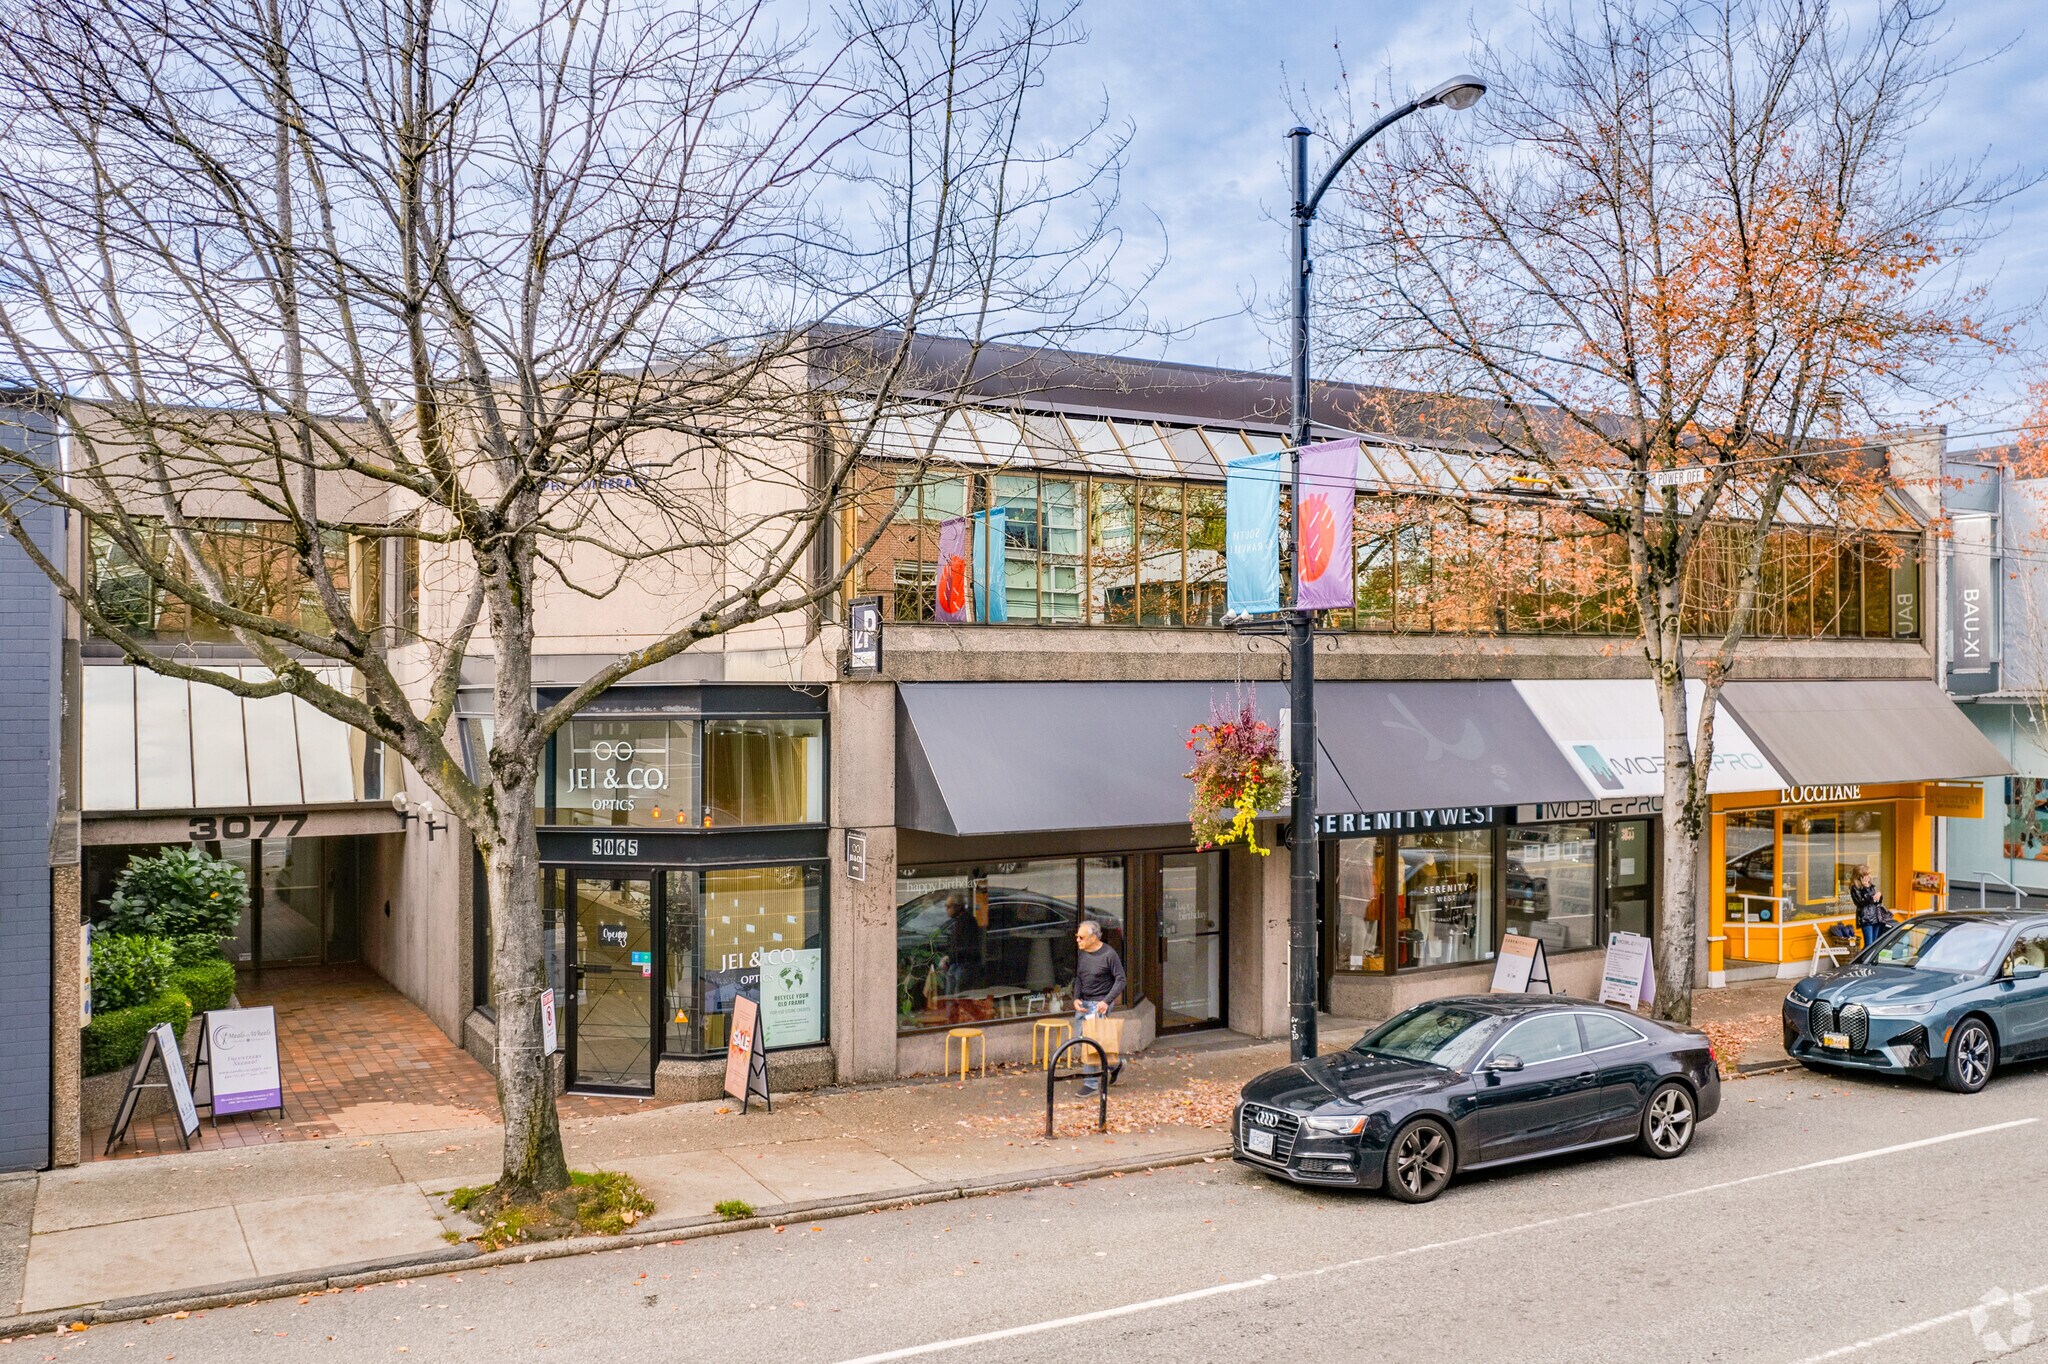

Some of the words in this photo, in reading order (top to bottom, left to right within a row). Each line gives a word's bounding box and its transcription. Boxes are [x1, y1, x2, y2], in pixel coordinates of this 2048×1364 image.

[1658, 472, 1684, 484] POWER
[1686, 470, 1701, 482] OFF
[1963, 588, 1980, 658] BAU-XI
[567, 768, 597, 793] JEI
[603, 768, 620, 789] &
[626, 768, 668, 790] CO.
[592, 799, 635, 811] OPTICS
[189, 813, 309, 840] 3077
[592, 838, 638, 857] 3065
[906, 880, 937, 895] happy
[938, 877, 979, 890] birthday
[1423, 883, 1469, 895] SERENITY
[1436, 894, 1457, 903] WEST
[720, 953, 744, 974] JEI
[748, 951, 762, 968] &
[768, 948, 799, 966] CO.
[740, 973, 775, 985] OPTICS
[228, 1031, 245, 1039] Meals
[250, 1029, 272, 1037] Wheels
[733, 1030, 750, 1052] SALE
